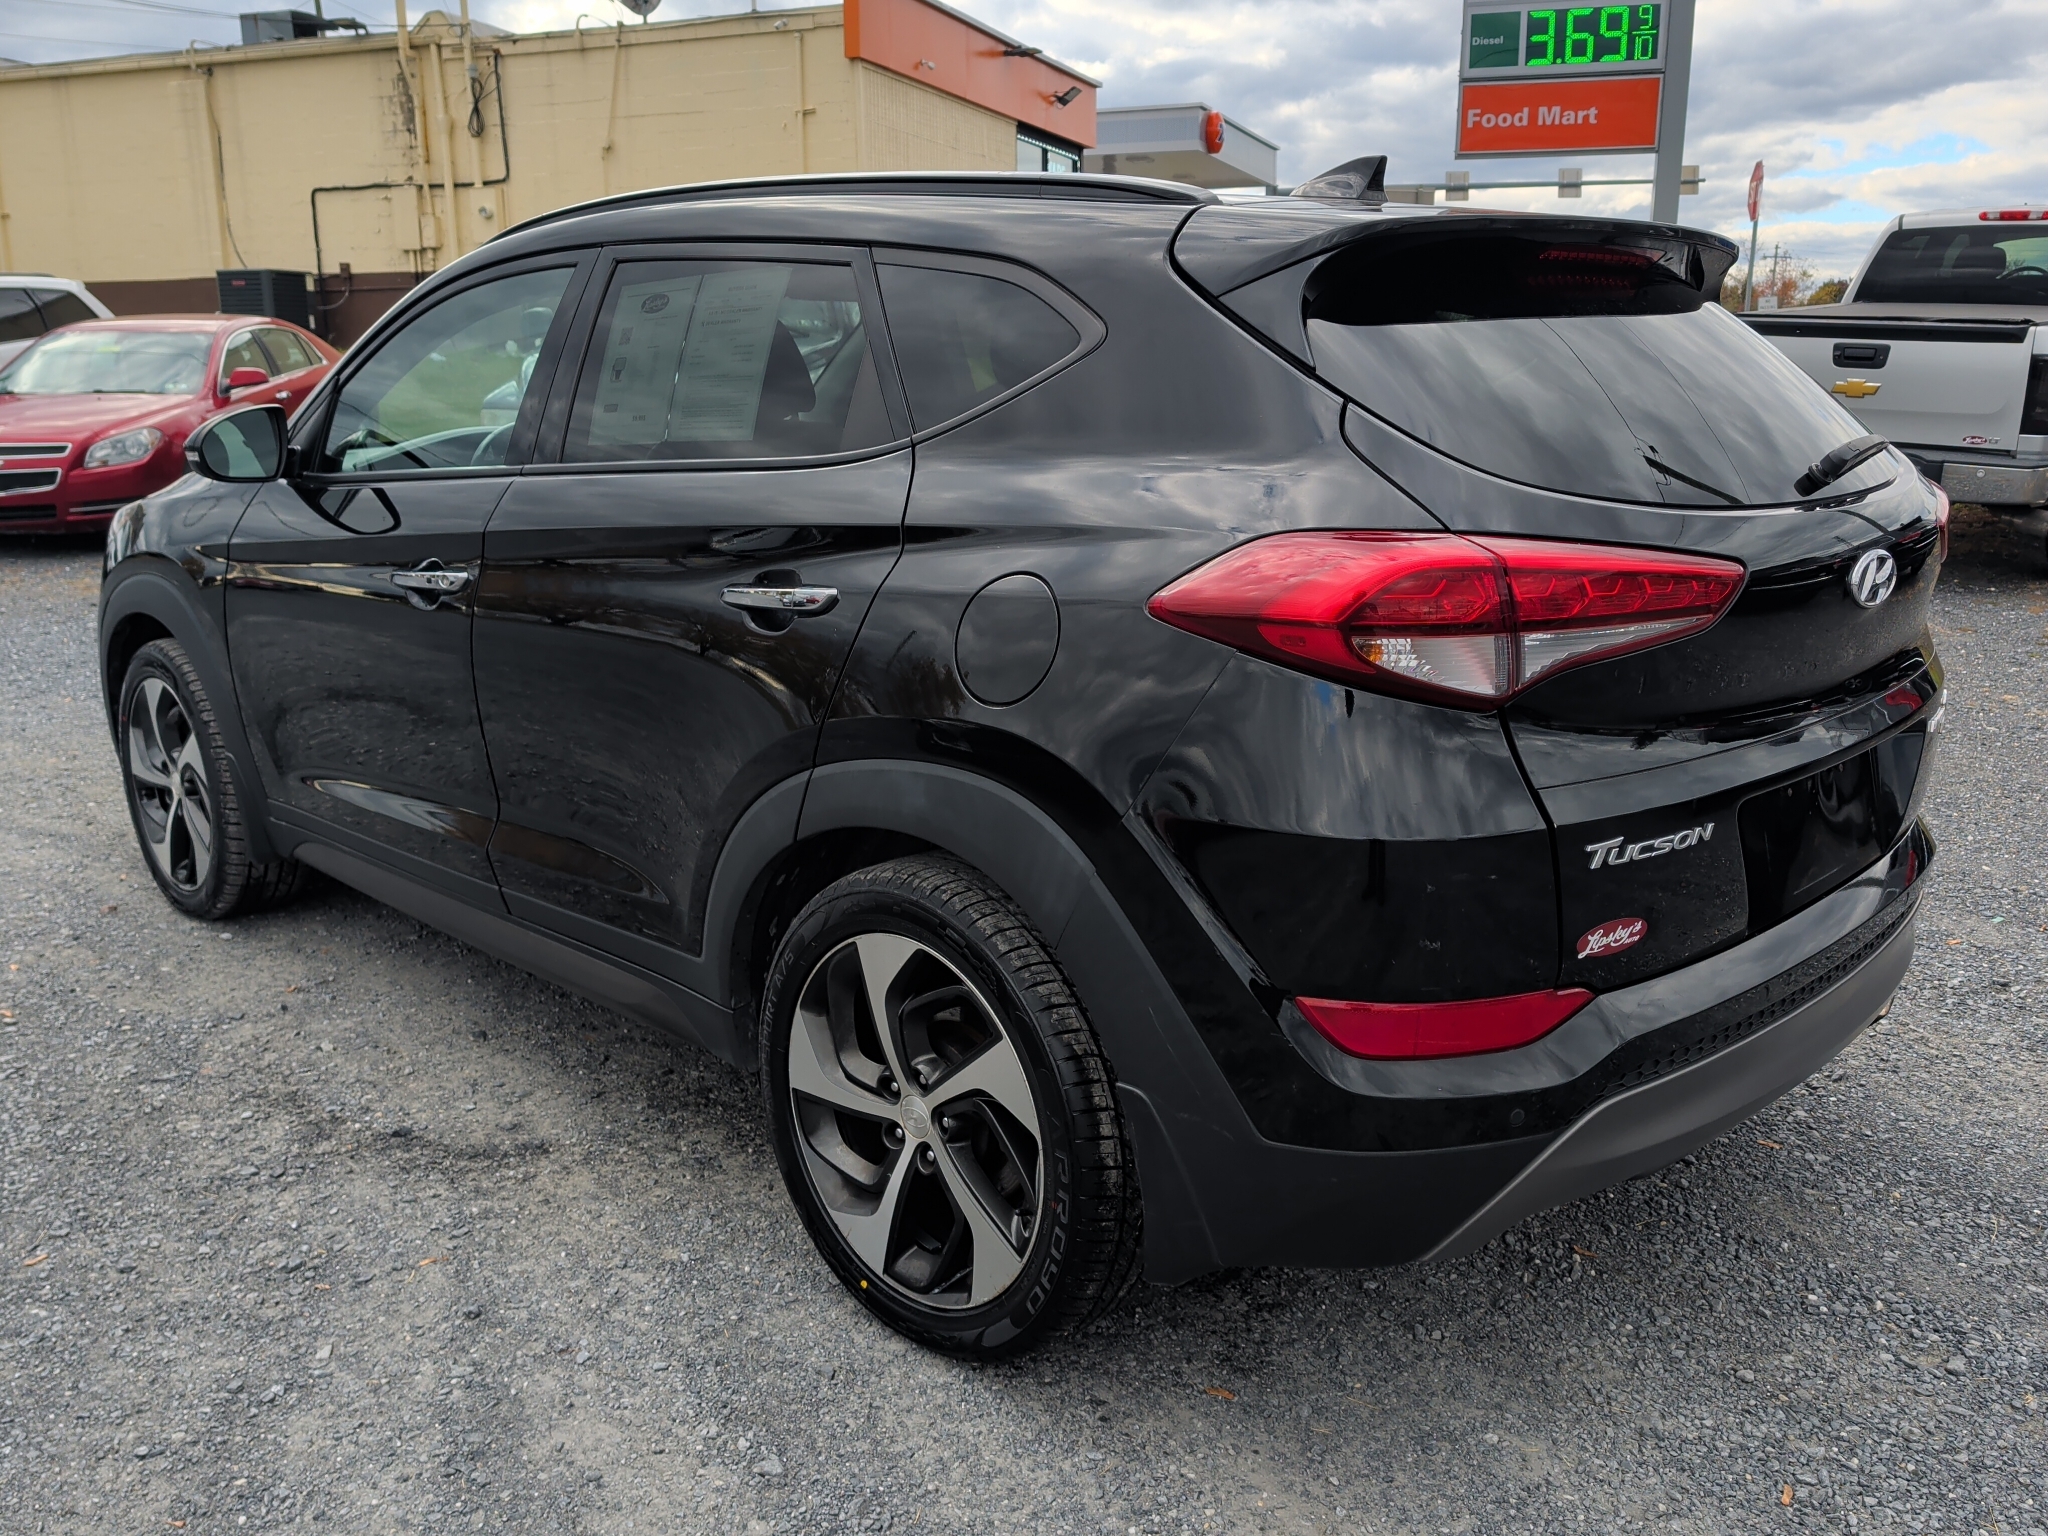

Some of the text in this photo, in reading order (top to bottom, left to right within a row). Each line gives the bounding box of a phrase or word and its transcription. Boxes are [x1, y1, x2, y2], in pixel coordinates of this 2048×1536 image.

[1472, 35, 1504, 46] Diesel
[1527, 6, 1630, 66] 3.69
[1467, 106, 1599, 128] Food Mart
